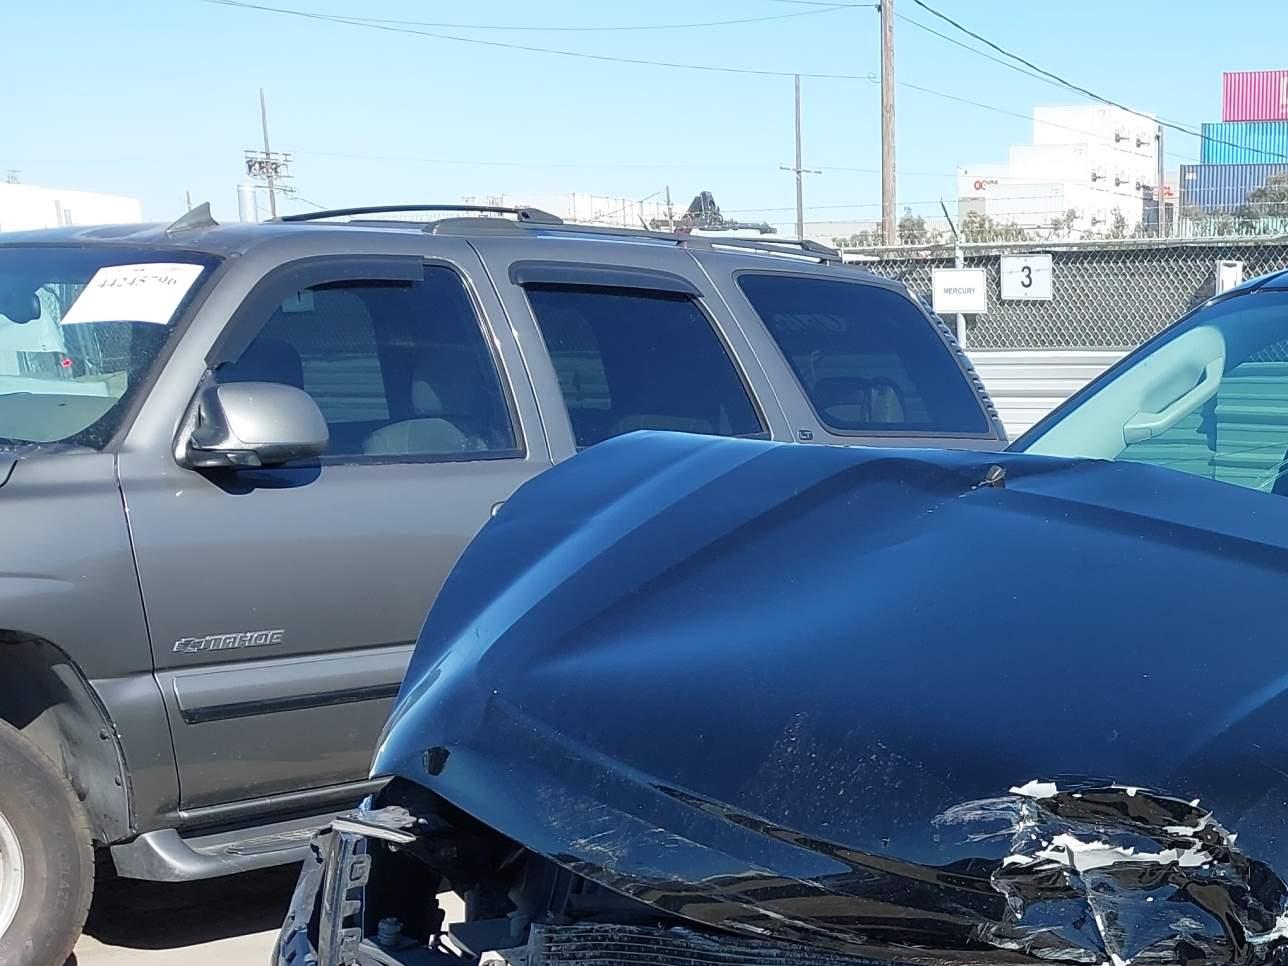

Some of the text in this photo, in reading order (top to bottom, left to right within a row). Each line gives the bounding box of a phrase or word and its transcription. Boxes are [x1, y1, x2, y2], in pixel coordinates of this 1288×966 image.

[1020, 265, 1033, 288] 3
[943, 287, 976, 295] MERCURY
[205, 629, 285, 651] TAHOE
